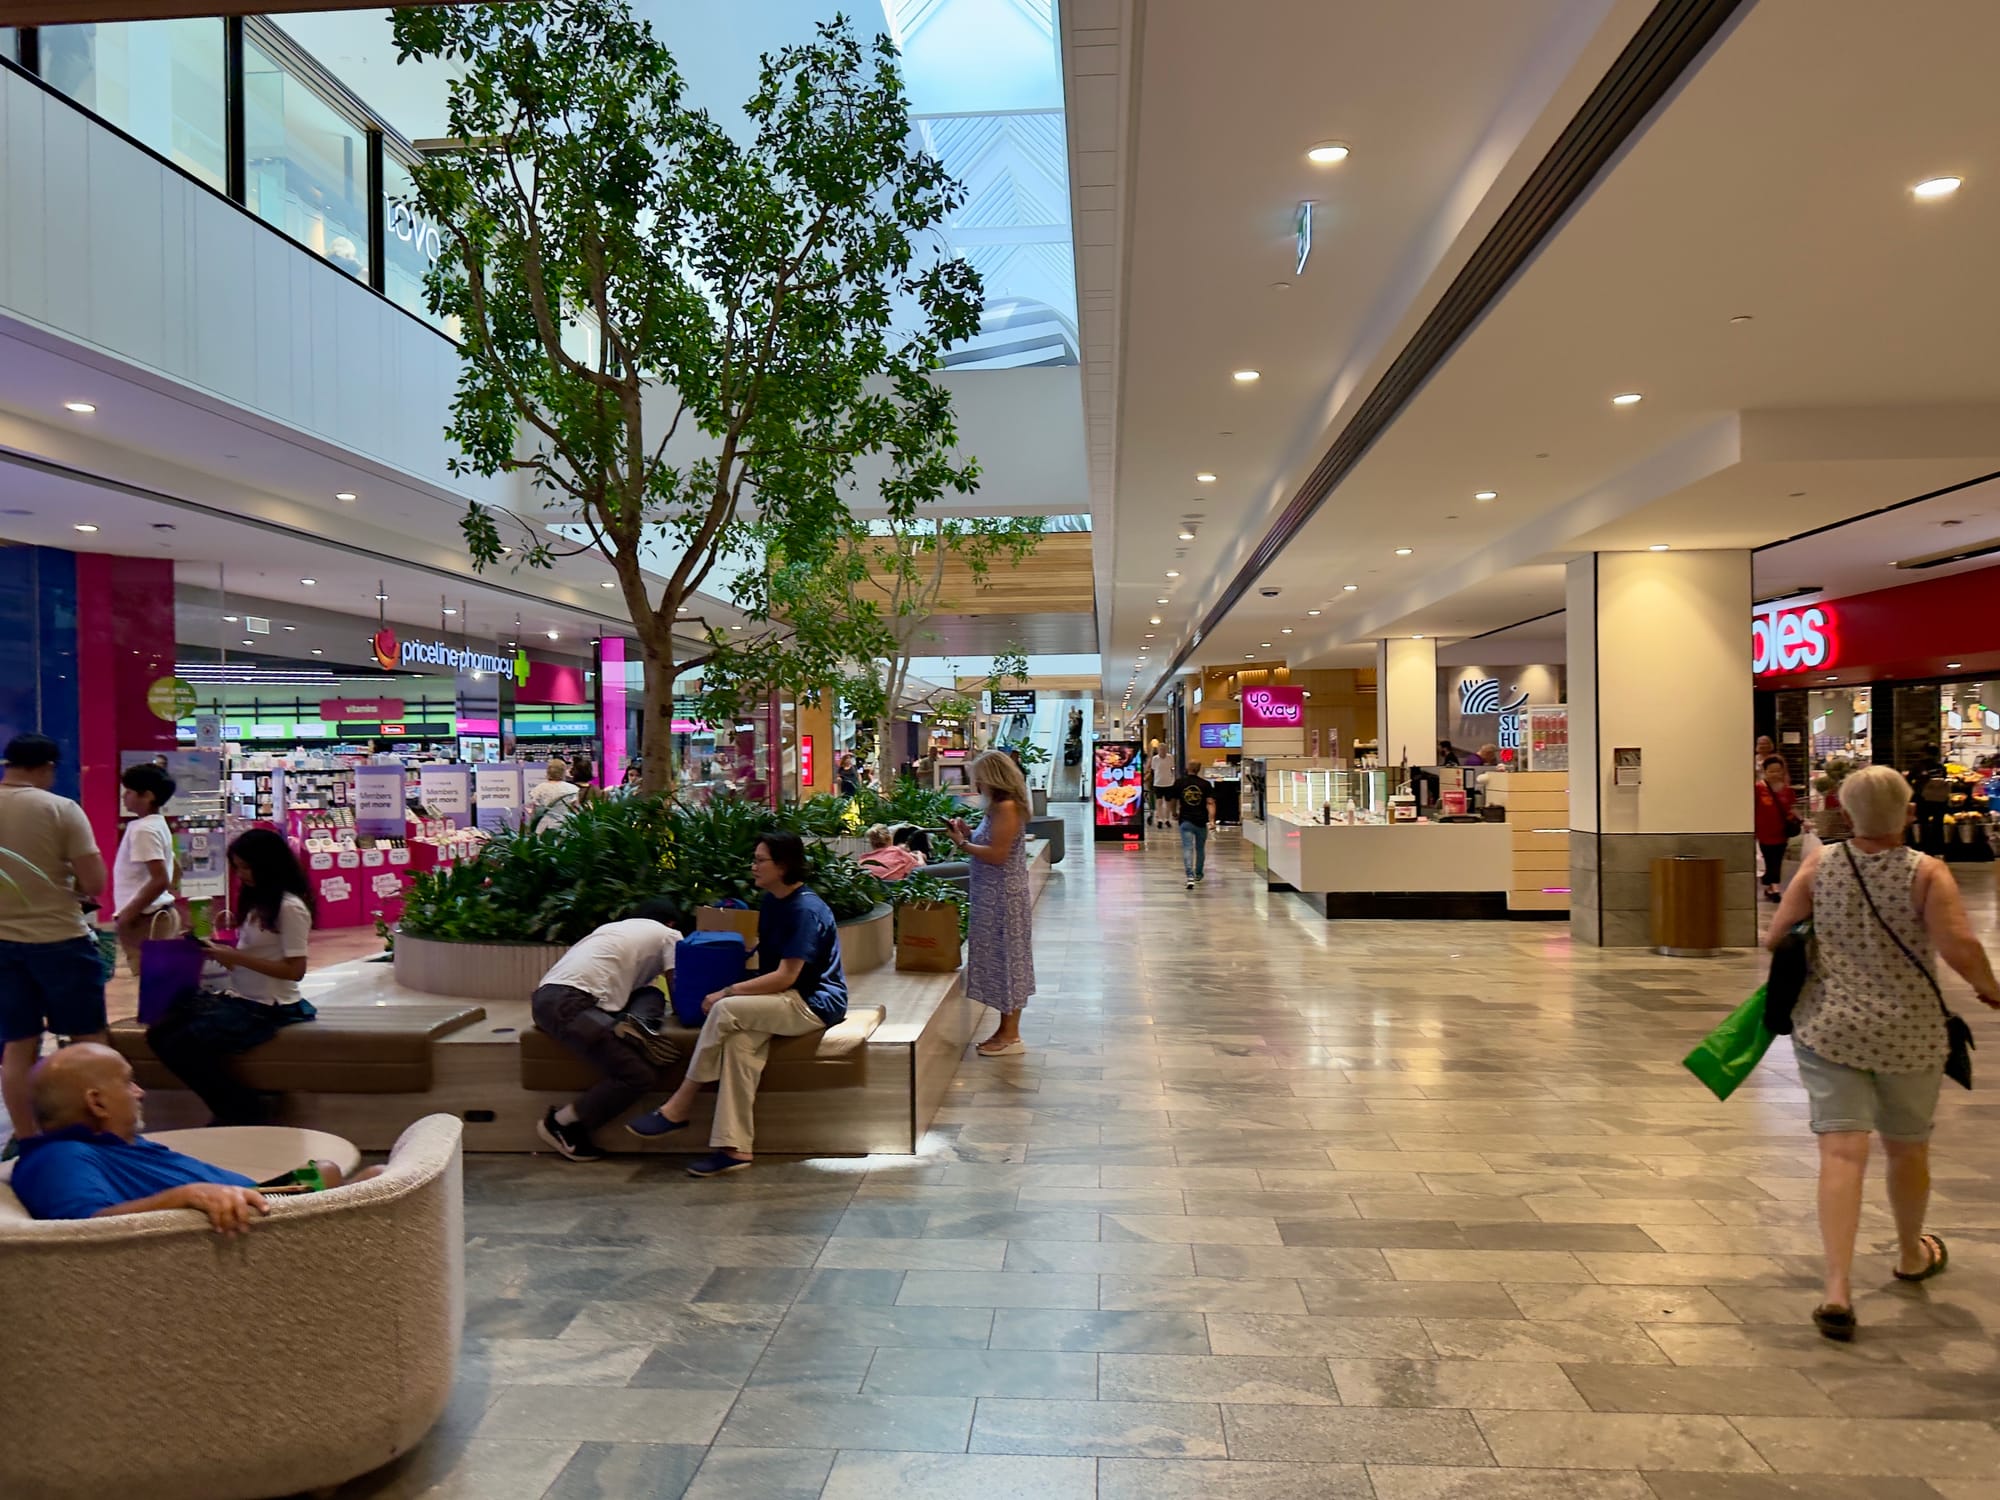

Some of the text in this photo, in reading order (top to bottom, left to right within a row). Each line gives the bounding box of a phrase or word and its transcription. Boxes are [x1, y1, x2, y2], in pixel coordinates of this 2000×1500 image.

[402, 639, 514, 680] priceline pharmacy
[1250, 693, 1269, 707] yo
[1261, 706, 1297, 719] way
[360, 792, 392, 800] Members
